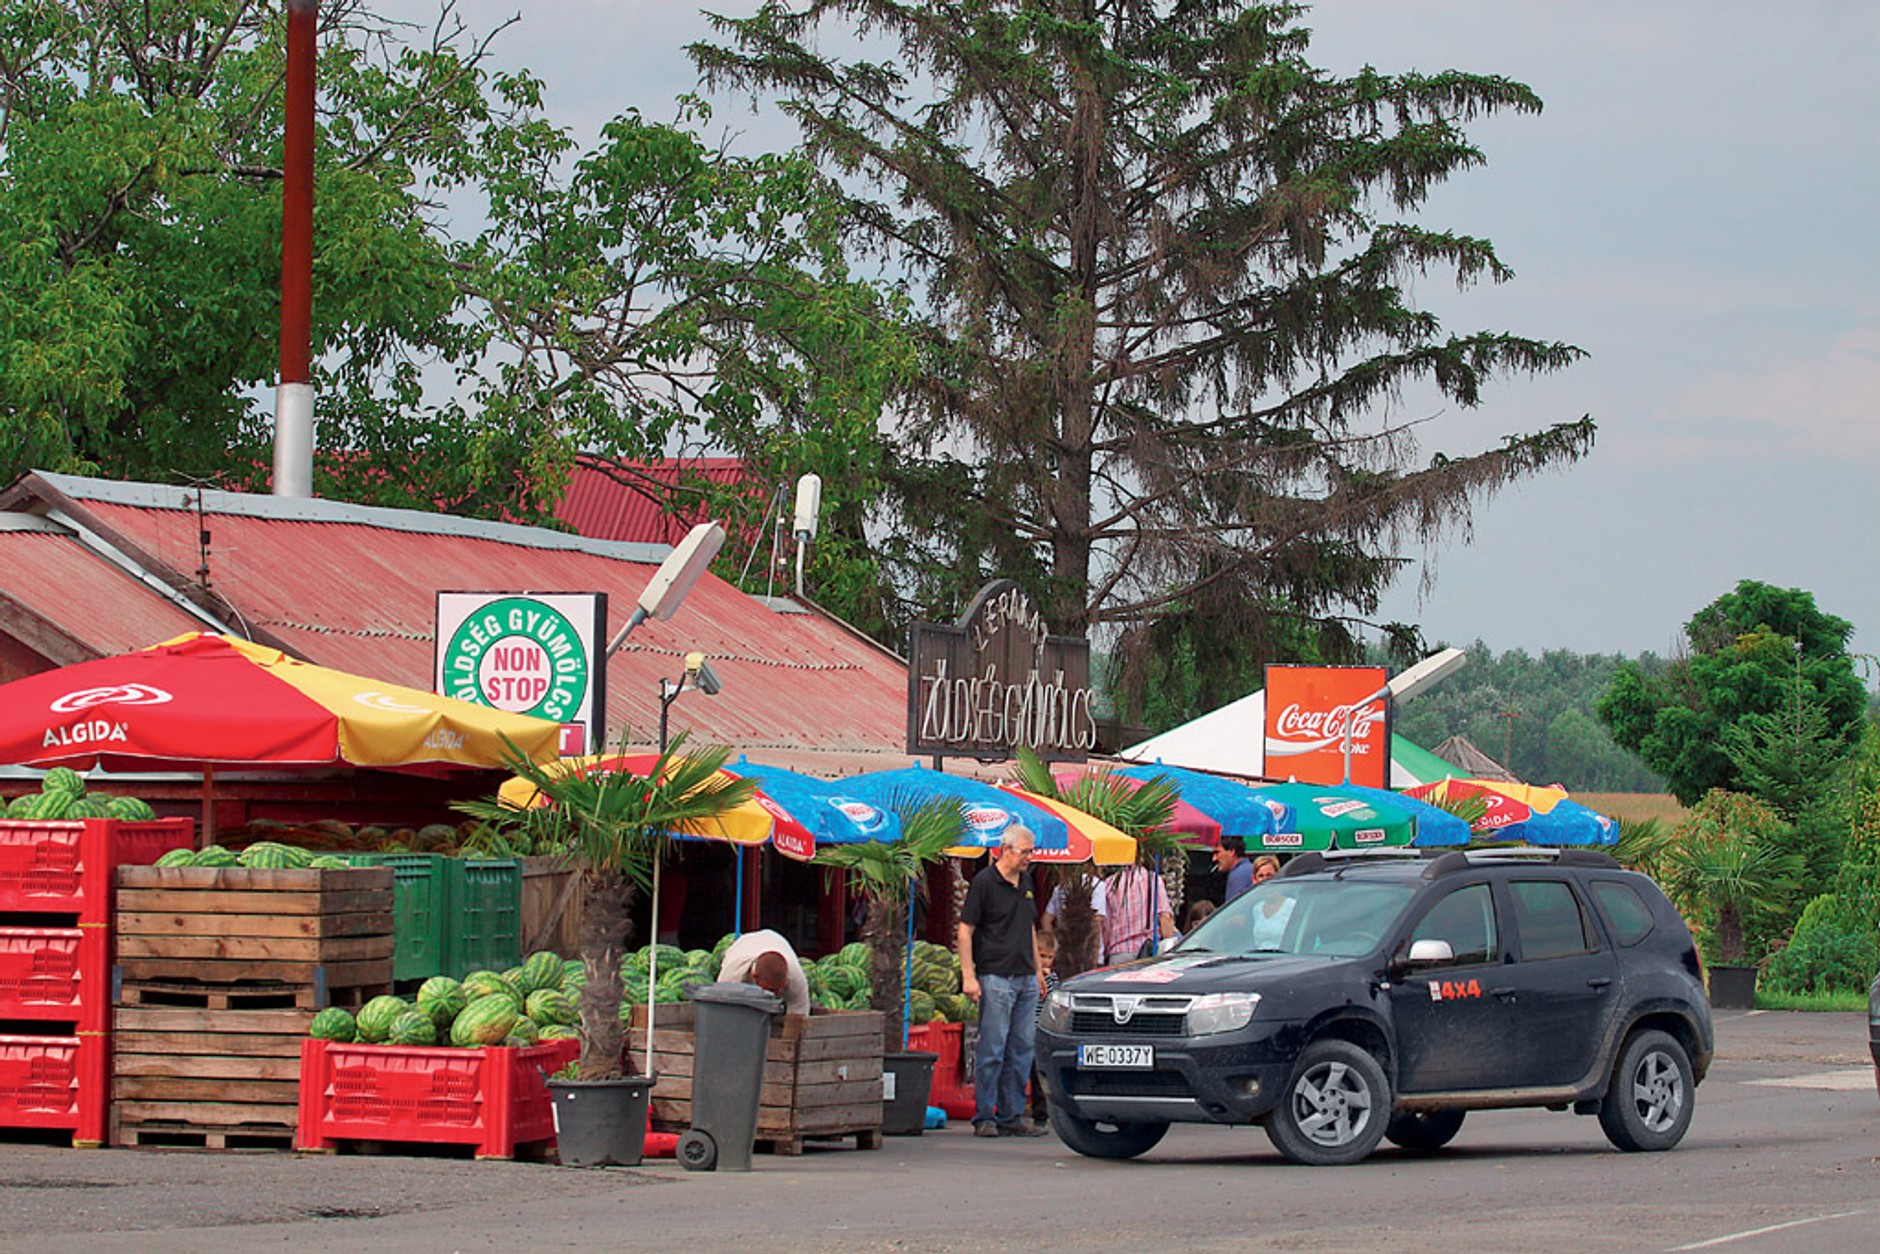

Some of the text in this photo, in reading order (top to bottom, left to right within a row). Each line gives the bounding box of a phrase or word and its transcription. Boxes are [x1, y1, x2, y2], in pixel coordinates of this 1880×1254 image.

[452, 608, 582, 720] ÖLDSÉG GYÜMÖLCS
[494, 647, 541, 671] NON
[488, 677, 547, 701] STOP
[43, 720, 127, 748] ALGIDA
